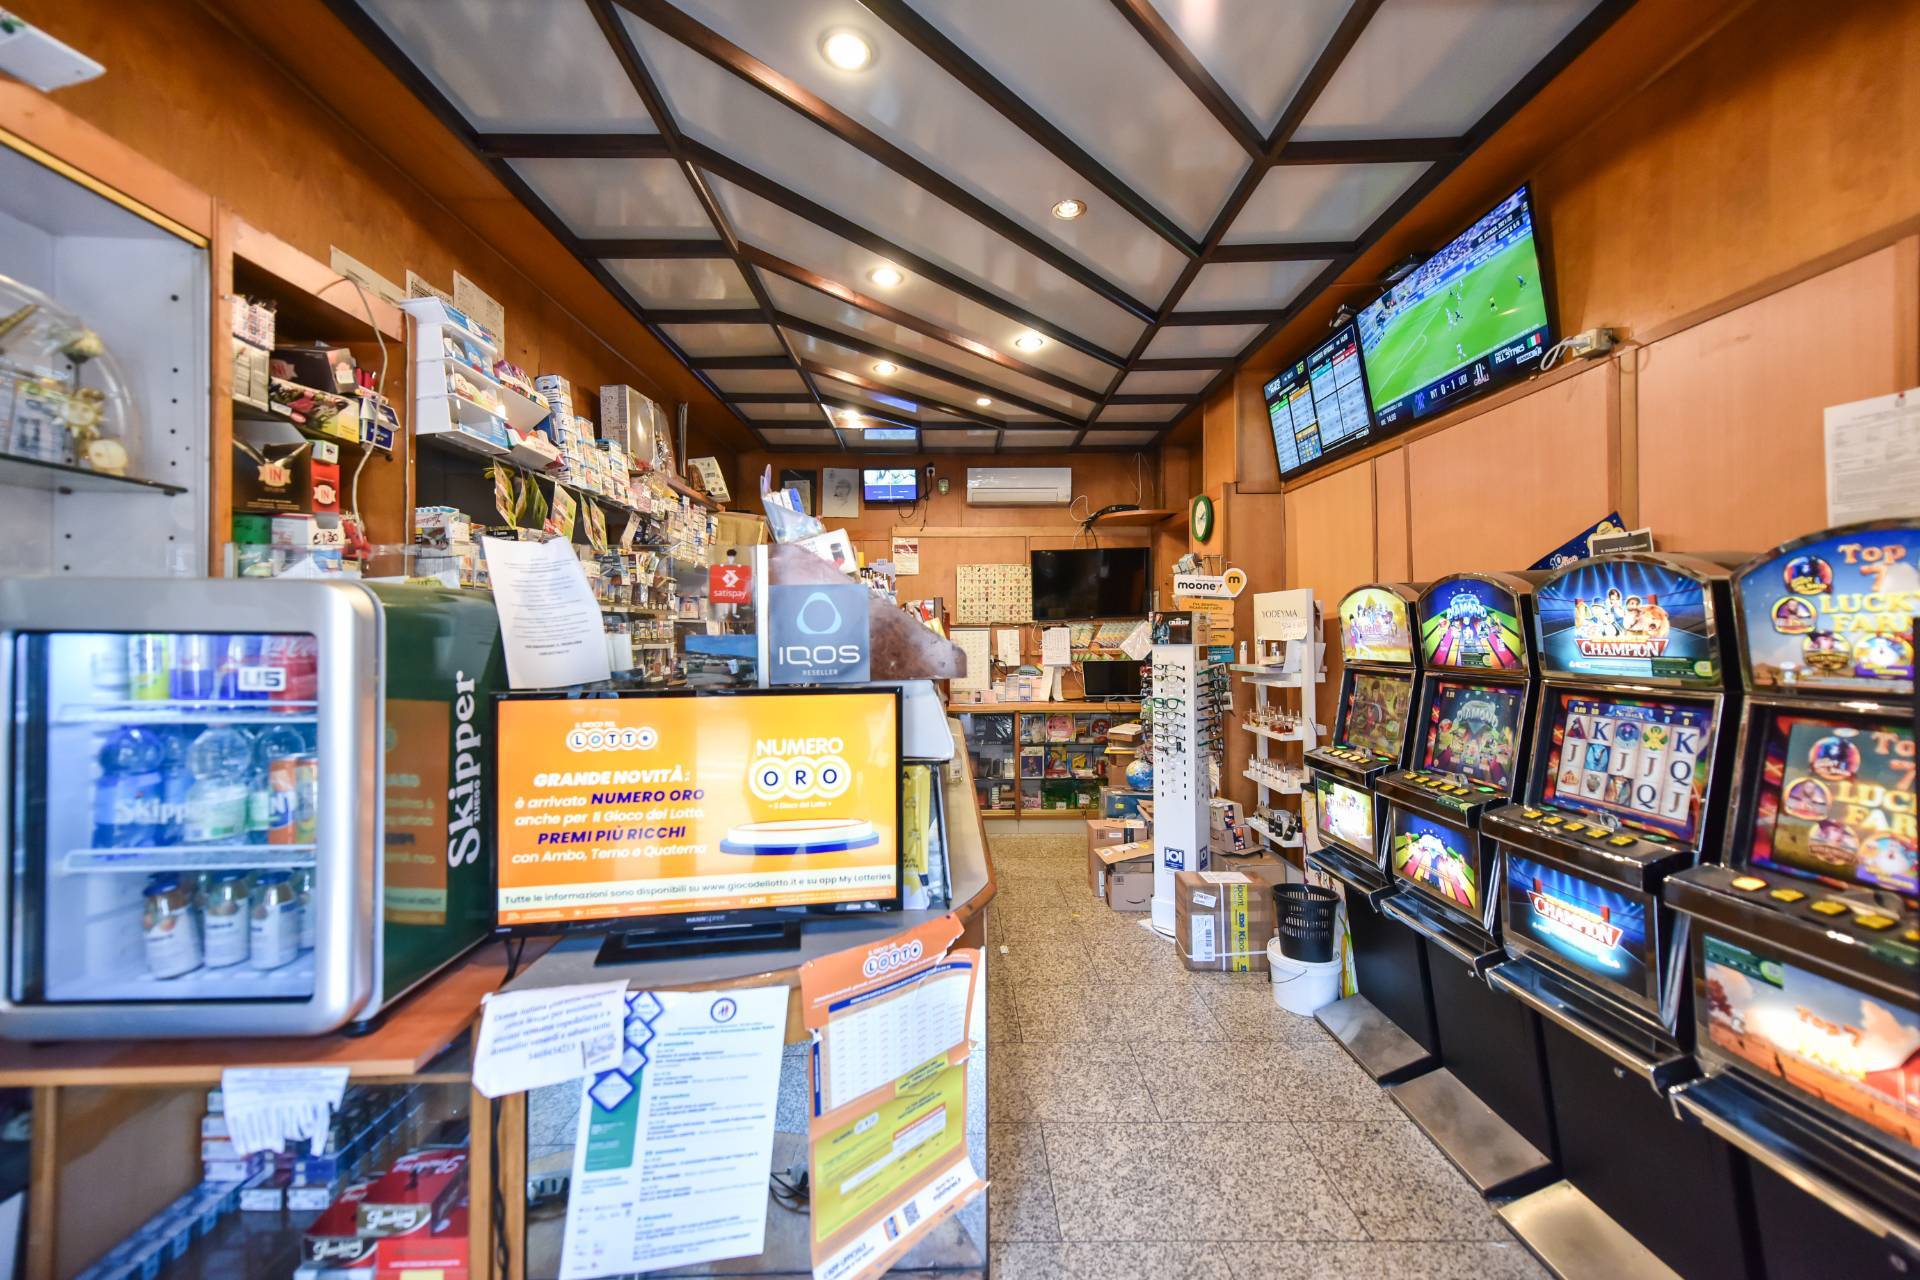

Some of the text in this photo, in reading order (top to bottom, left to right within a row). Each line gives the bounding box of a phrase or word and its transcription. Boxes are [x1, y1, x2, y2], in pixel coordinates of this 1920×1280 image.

[1451, 379, 1456, 389] 1
[269, 471, 282, 481] IN
[320, 489, 329, 499] IN
[1838, 543, 1906, 565] Top
[1177, 581, 1222, 593] mooney
[1859, 565, 1888, 592] 7
[713, 589, 747, 600] satispay
[1261, 609, 1298, 618] YODEYMA
[779, 645, 861, 667] IQOS
[1580, 640, 1660, 657] CHAMPION
[1591, 721, 1611, 741] K
[756, 736, 844, 756] NUMERO
[1568, 744, 1579, 763] J
[1675, 732, 1697, 755] K
[1870, 732, 1916, 757] To
[448, 670, 481, 868] Skipper
[1616, 752, 1628, 772] J
[1644, 757, 1657, 777] J
[533, 765, 690, 787] GRANDE NOVITÀ:
[763, 768, 837, 787] ORO
[1669, 760, 1692, 786] Q
[1889, 759, 1916, 790] 7
[528, 795, 587, 809] arrivato
[591, 790, 665, 805] NUMERO
[669, 789, 705, 801] ORO
[1637, 784, 1656, 809] Q
[1669, 792, 1684, 813] J
[1836, 781, 1917, 813] LUC
[515, 813, 560, 827] anche
[562, 813, 587, 827] per
[604, 809, 643, 823] Gioco
[646, 808, 668, 820] del
[538, 825, 686, 845] PREMI PIÙ RICCHI
[512, 843, 708, 864] con Ambo, Terno e Quaterna
[505, 896, 531, 905] Tutte
[545, 890, 608, 902] informazioni
[611, 888, 635, 897] sono
[636, 885, 687, 897] disponibili
[702, 878, 797, 893] www.giocodellotto.it
[807, 878, 818, 886] su
[820, 876, 837, 887] app
[840, 875, 851, 884] My
[854, 872, 891, 883] Lotteries
